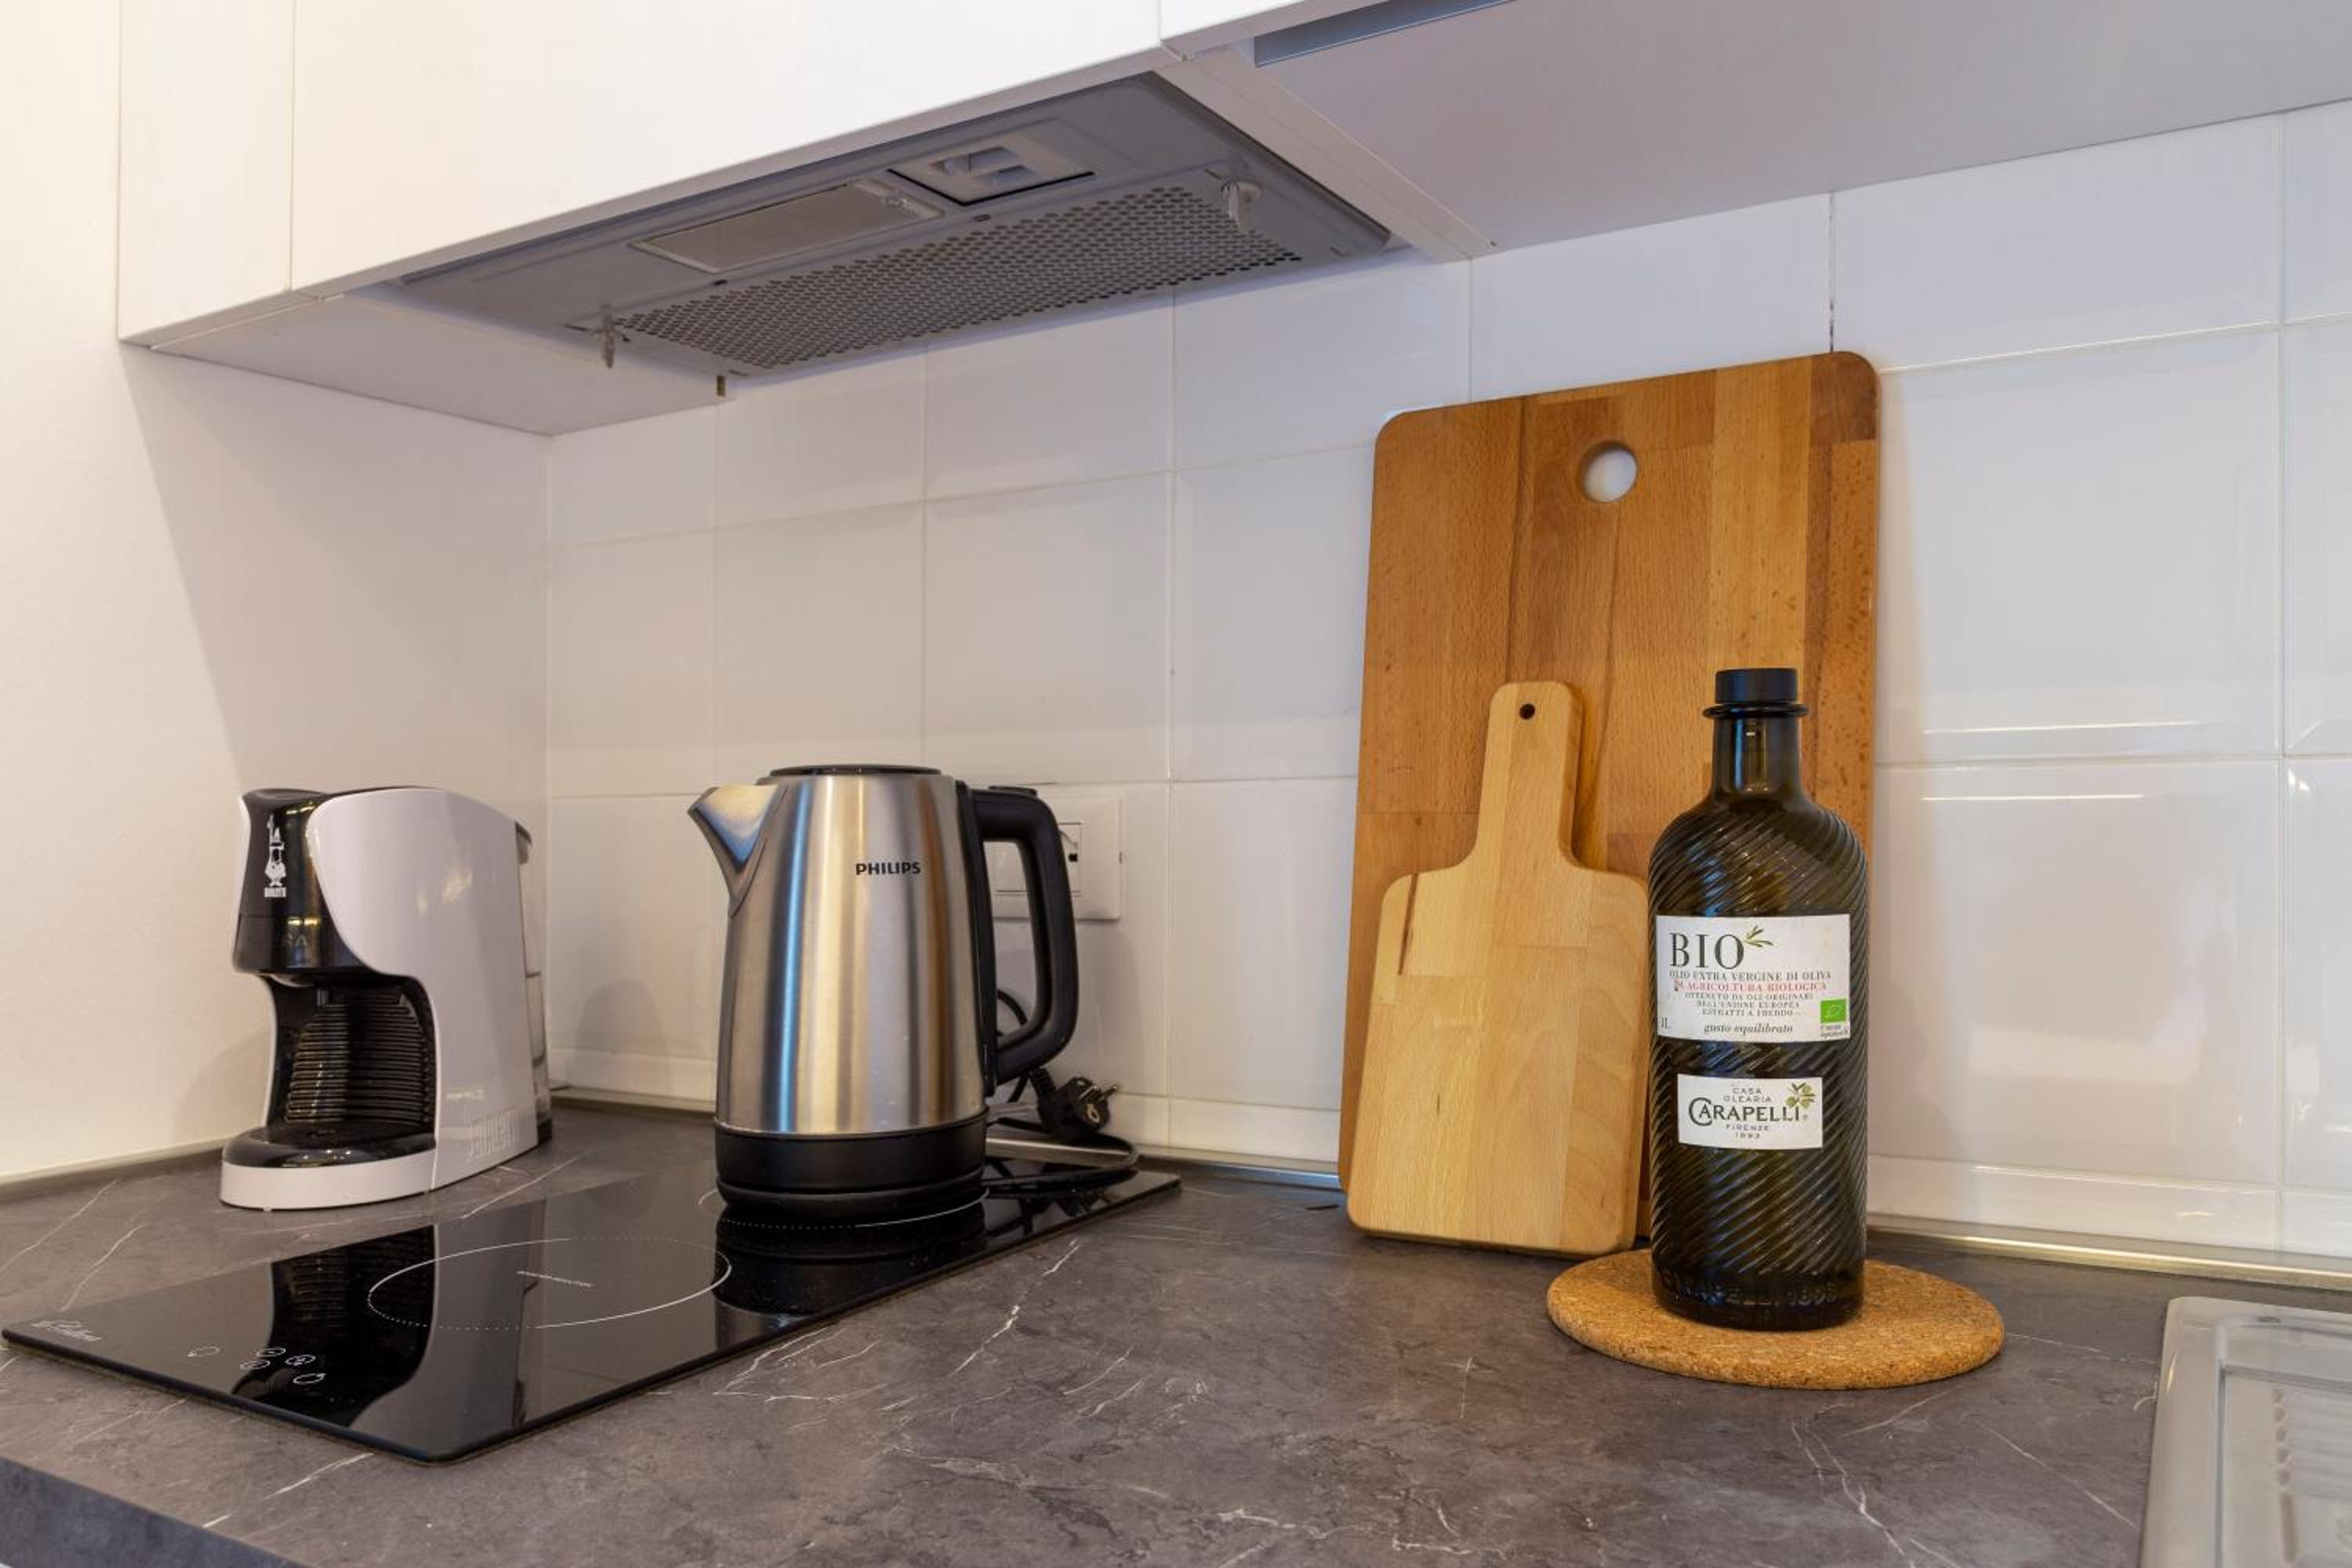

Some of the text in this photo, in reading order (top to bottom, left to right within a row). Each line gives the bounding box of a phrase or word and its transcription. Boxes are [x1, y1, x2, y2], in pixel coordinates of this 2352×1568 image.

[855, 862, 921, 876] PHILIPS
[1669, 932, 1744, 970] BIO
[1669, 970, 1831, 982] OLIO EXTRA VERGINE DI OLIVA
[1686, 982, 1762, 992] AGRICOLTURA
[1767, 982, 1827, 992] BIOLOGICA
[1685, 992, 1728, 1000] OTTENUTO
[1704, 1022, 1794, 1036] gusto equilibrato
[1732, 1087, 1762, 1095] CASA
[1688, 1097, 1800, 1127] CARAPELLI
